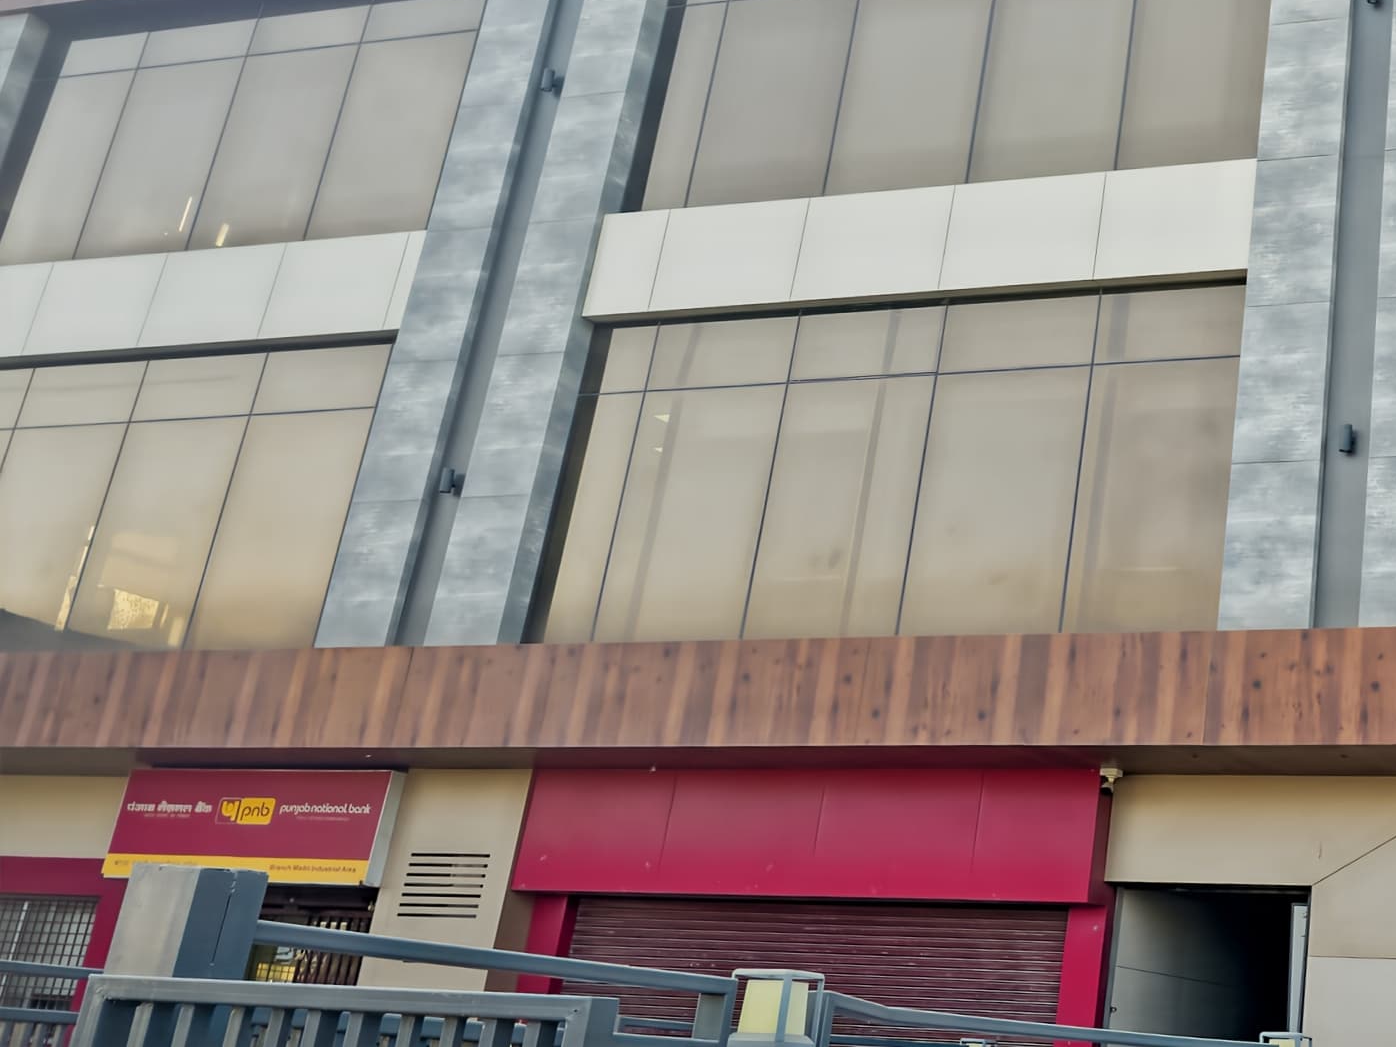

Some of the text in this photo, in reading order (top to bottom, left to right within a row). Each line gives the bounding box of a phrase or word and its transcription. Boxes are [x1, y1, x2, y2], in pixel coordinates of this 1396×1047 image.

[240, 802, 270, 821] pnb
[279, 803, 371, 815] punjab national bank
